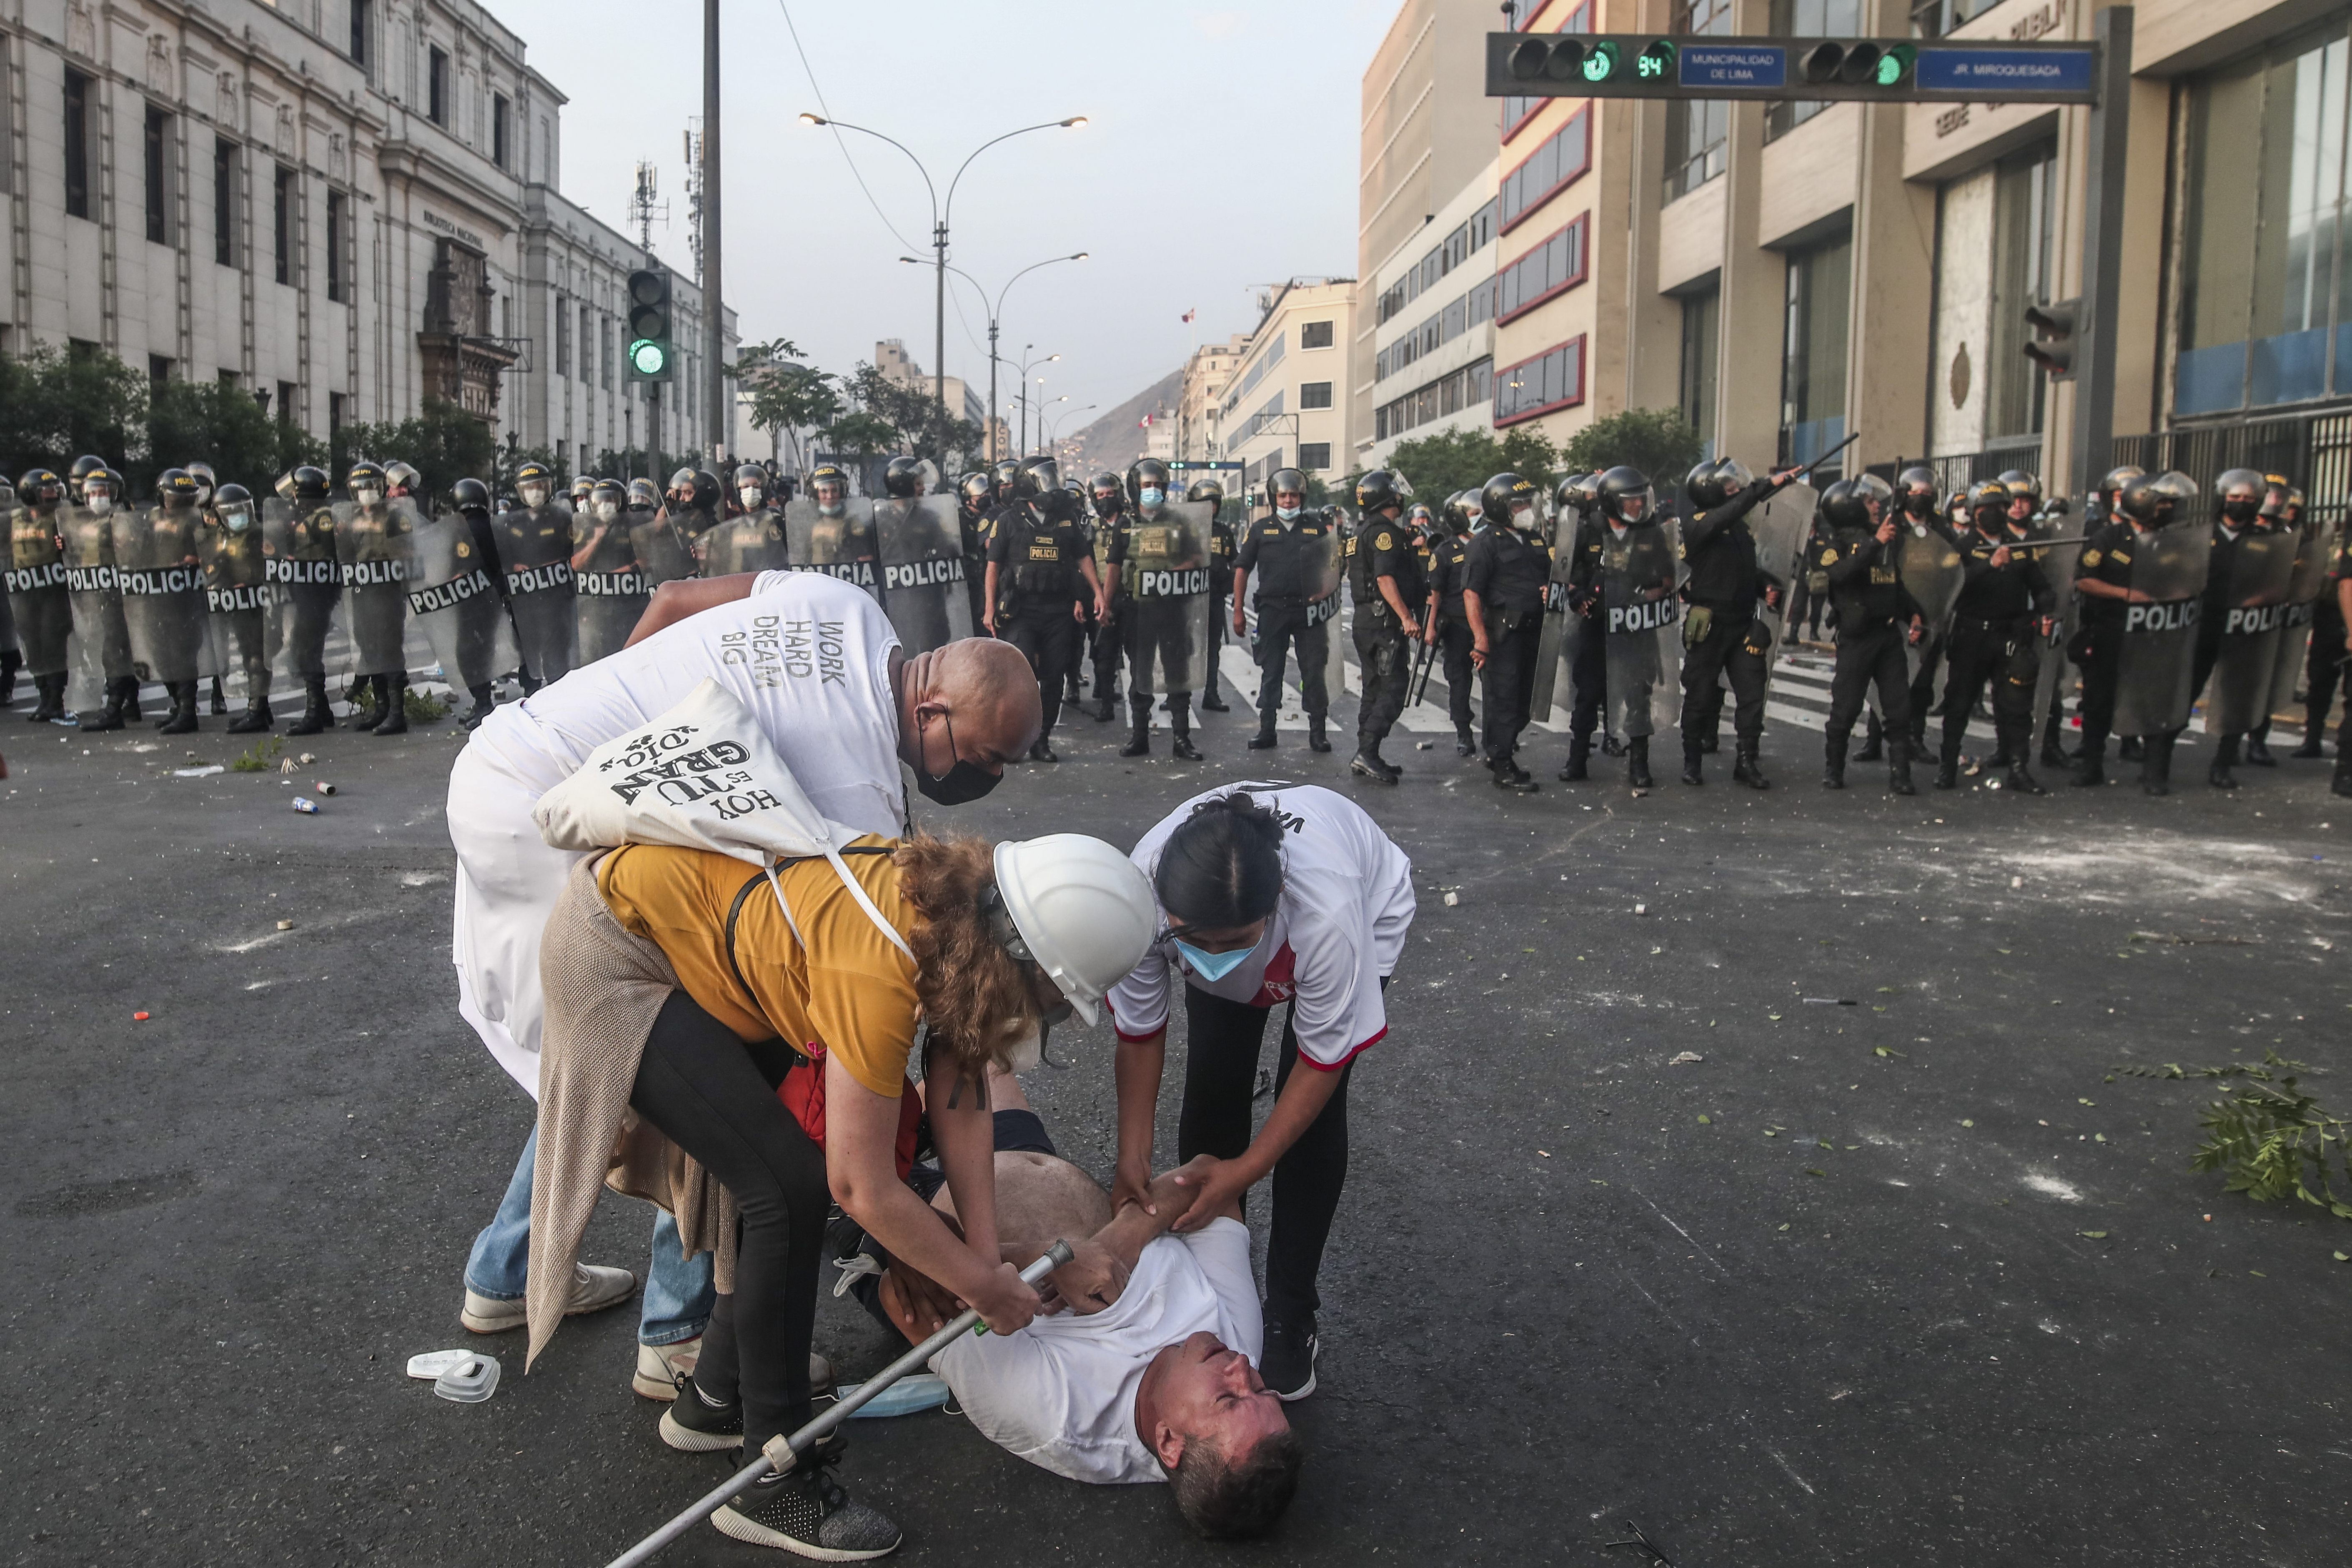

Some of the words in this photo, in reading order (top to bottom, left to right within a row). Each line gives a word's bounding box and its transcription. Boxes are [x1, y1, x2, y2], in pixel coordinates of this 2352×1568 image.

[1638, 55, 1661, 77] 94
[1691, 54, 1774, 66] MUNICIPALIDAD
[1711, 69, 1726, 79] DE
[1728, 69, 1754, 80] LIMA
[1973, 64, 2061, 77] MIROQUESADA
[1032, 549, 1057, 558] POLICIA
[4, 563, 66, 593] POLIC
[66, 566, 120, 591] POLICI
[119, 567, 207, 596] POLICIA
[507, 563, 574, 595] POLICI
[885, 559, 964, 589] POLICIA
[1142, 570, 1209, 596] POLICIA
[207, 585, 291, 612] POLICIA
[409, 569, 491, 614] POLICIA
[2125, 601, 2197, 631] POLIC
[721, 632, 747, 665] BIG
[753, 616, 782, 690] DREAM
[785, 620, 813, 678] HARD
[819, 621, 846, 688] WORK
[610, 740, 750, 807] GRAN
[725, 771, 753, 783] ES
[657, 774, 736, 807] TU
[709, 789, 782, 820] HOY
